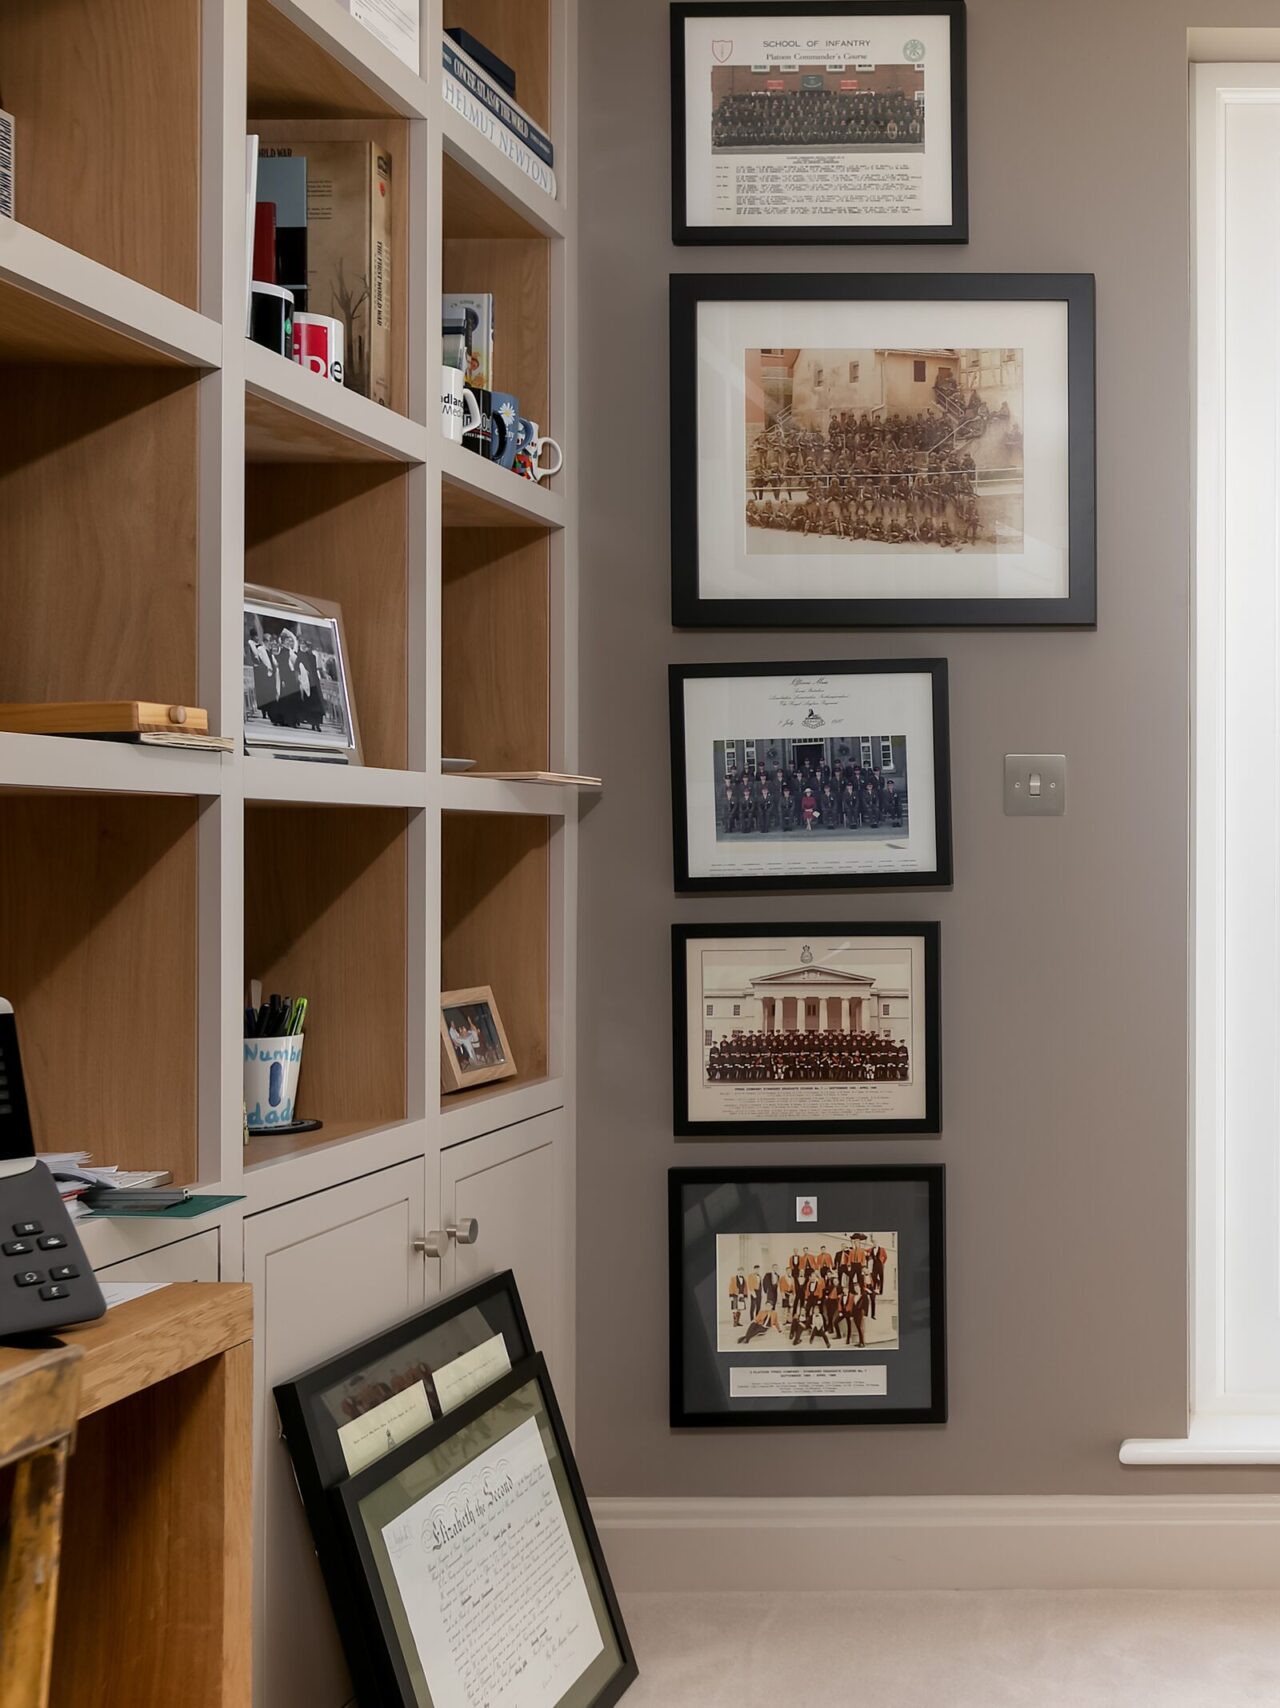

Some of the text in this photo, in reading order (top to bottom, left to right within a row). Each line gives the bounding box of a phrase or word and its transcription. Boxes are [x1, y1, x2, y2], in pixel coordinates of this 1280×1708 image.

[763, 40, 800, 48] SCHOOL
[825, 39, 871, 47] INFANTRY
[445, 78, 548, 189] HELMUT NEWTON
[432, 1497, 476, 1551] Elizabeth
[481, 1474, 514, 1507] Second
